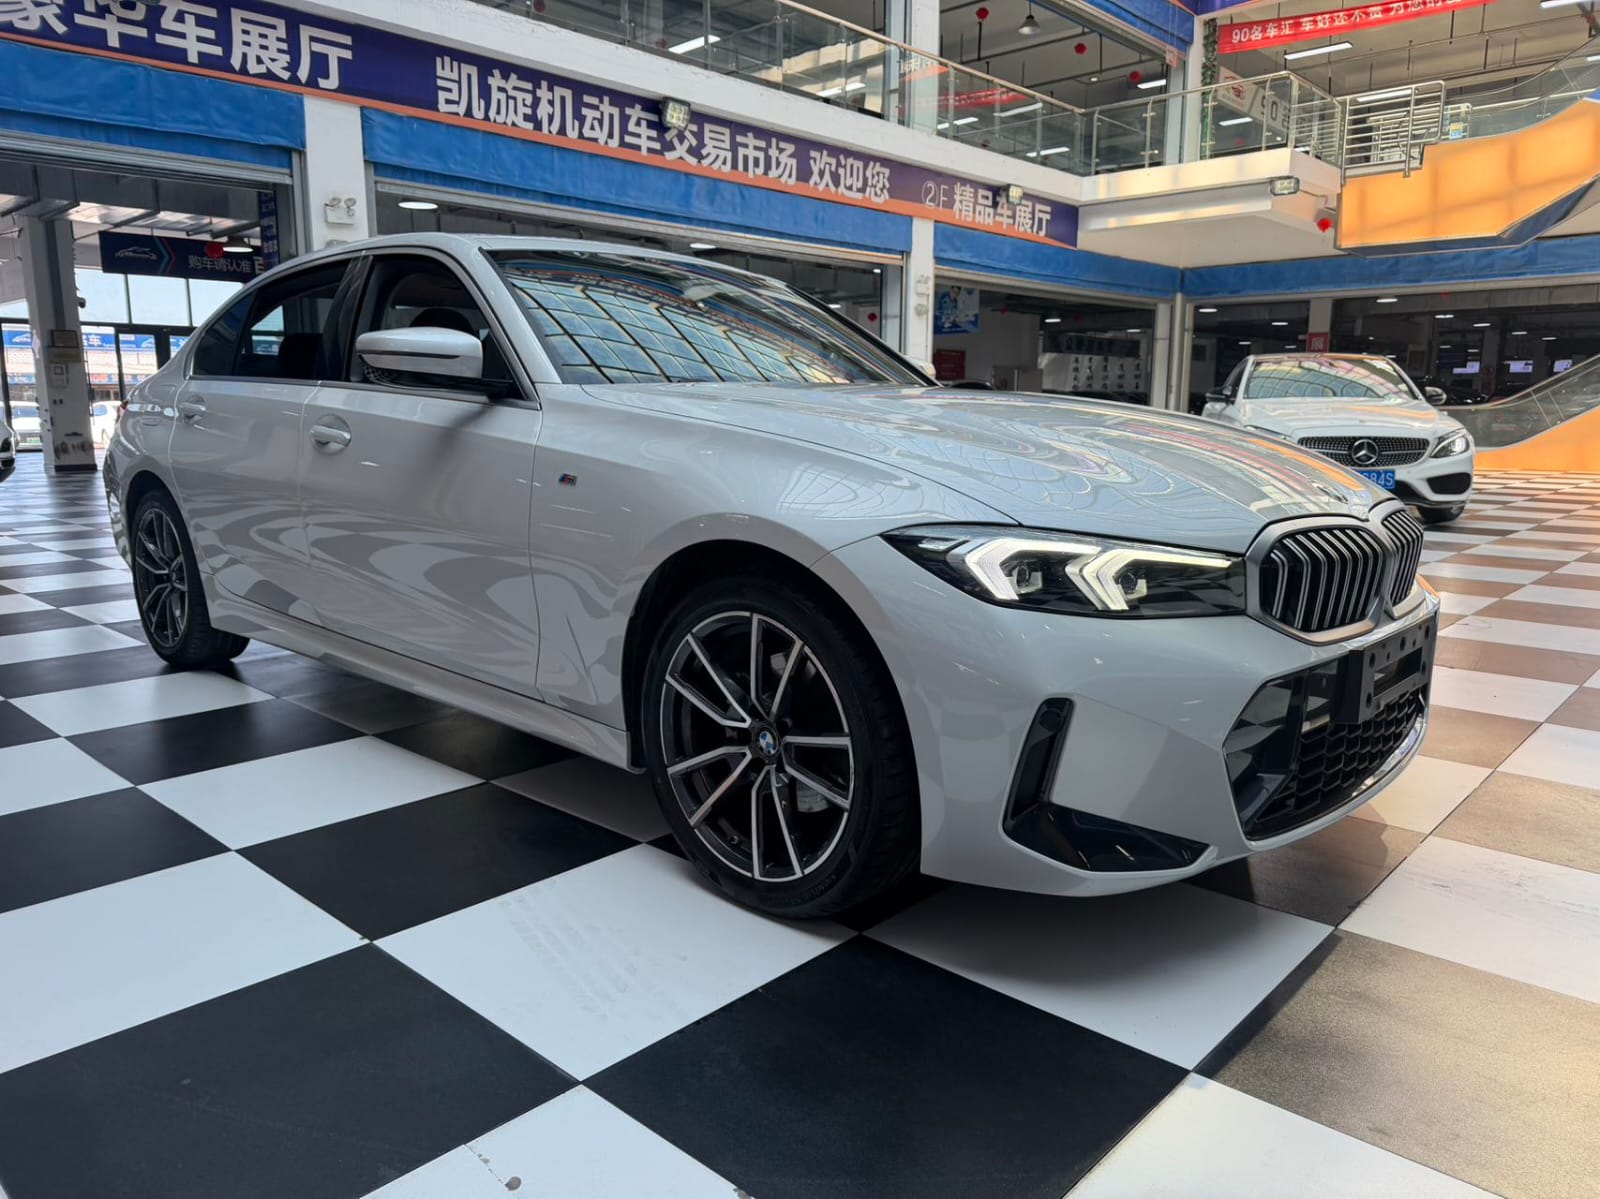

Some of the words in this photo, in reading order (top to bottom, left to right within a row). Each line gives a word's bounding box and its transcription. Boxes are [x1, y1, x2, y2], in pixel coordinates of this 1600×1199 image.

[1231, 20, 1295, 43] 90名车汇
[435, 55, 798, 185] 凯旋机动车交易市场
[808, 149, 891, 204] 欢迎您
[952, 181, 1052, 237] 精品车展厅
